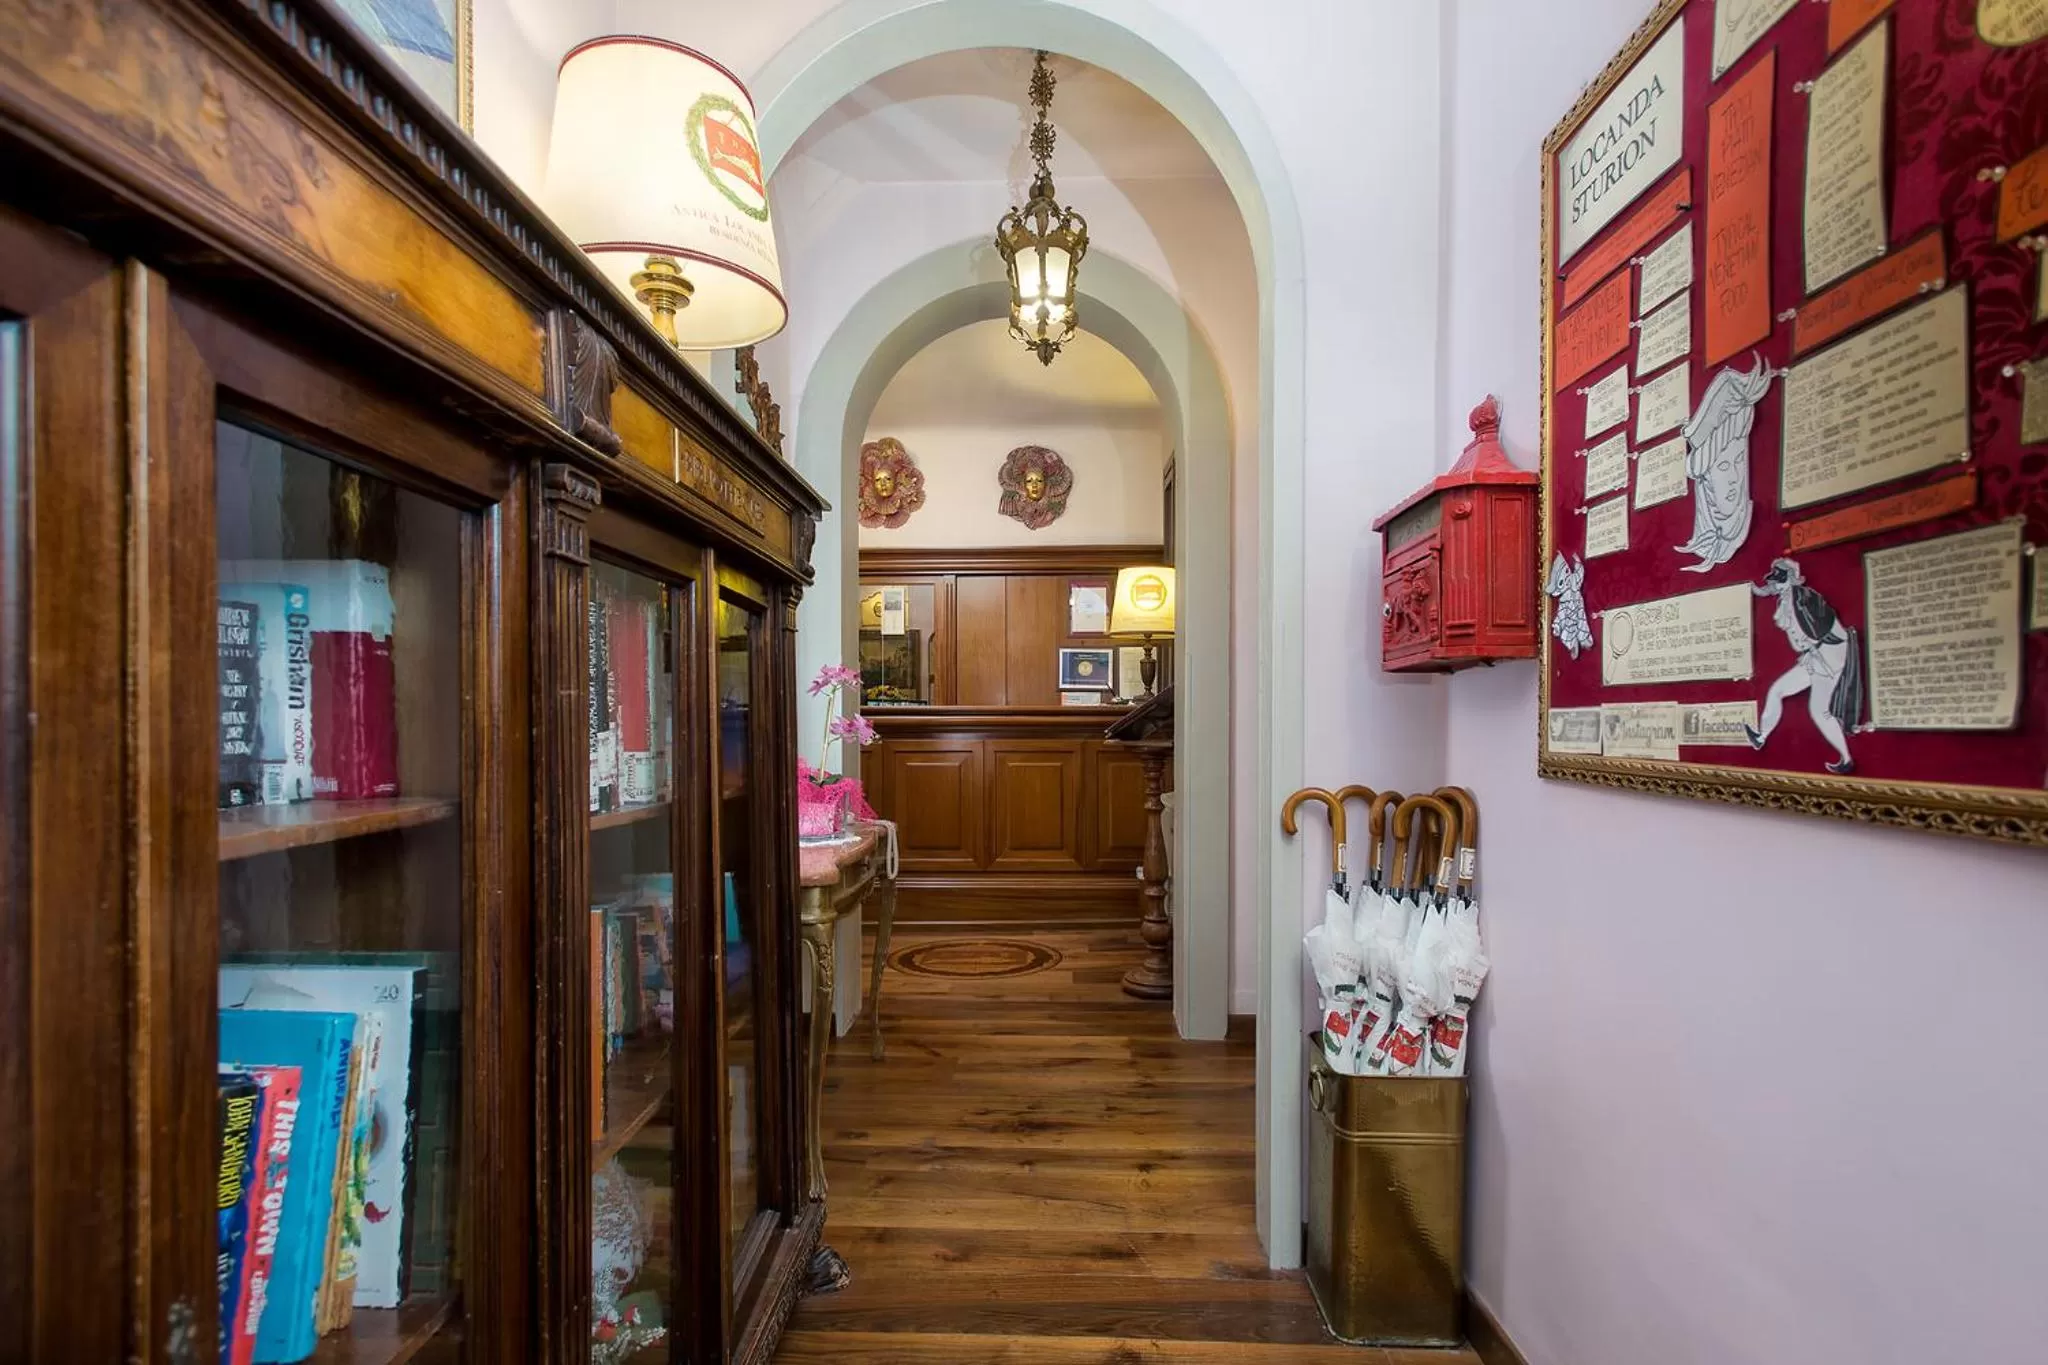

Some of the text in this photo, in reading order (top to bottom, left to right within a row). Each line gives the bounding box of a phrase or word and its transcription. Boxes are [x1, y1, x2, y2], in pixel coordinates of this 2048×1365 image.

[1570, 74, 1665, 190] LOCANDA
[1572, 117, 1658, 224] STURION
[286, 613, 310, 710] Grisham
[1620, 721, 1676, 748] Instagram
[224, 1094, 256, 1133] JOHN
[267, 1099, 300, 1156] THIS
[254, 1174, 290, 1256] TOWN
